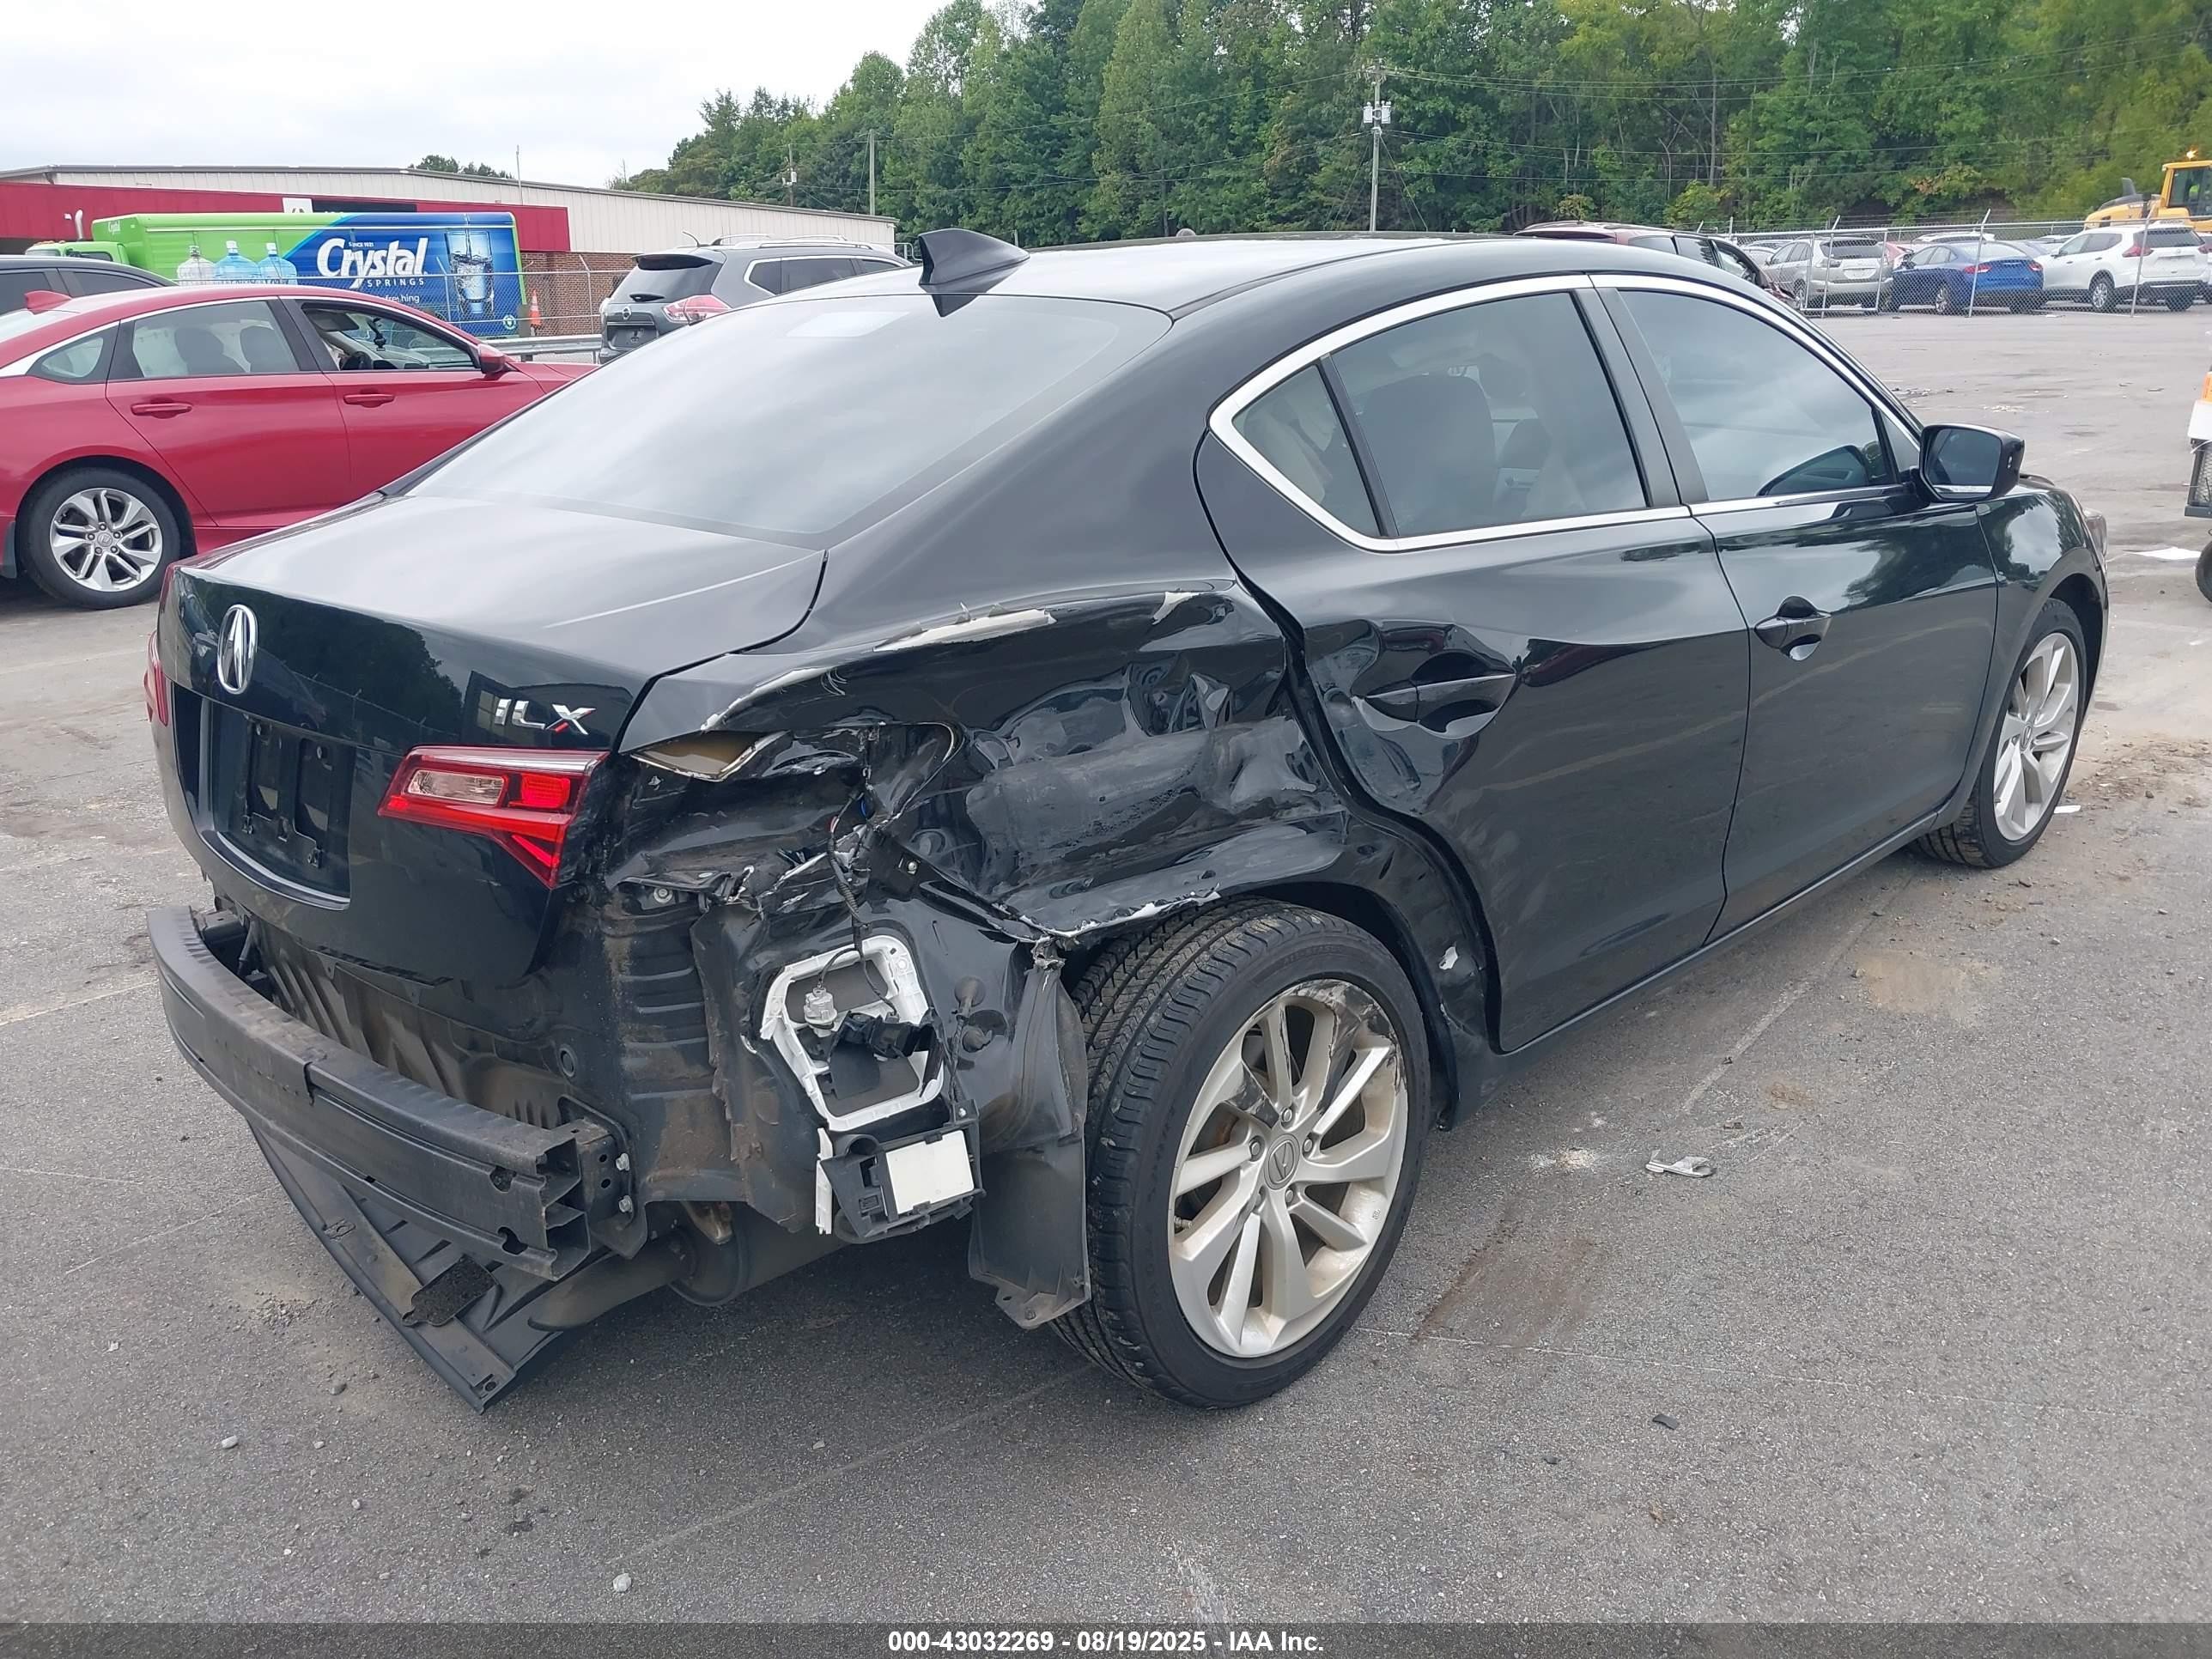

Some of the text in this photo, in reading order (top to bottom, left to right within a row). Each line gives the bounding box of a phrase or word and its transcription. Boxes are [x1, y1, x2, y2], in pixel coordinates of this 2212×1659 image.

[317, 237, 428, 289] Crystal
[367, 277, 424, 288] SPRINGS
[494, 698, 597, 735] ILX
